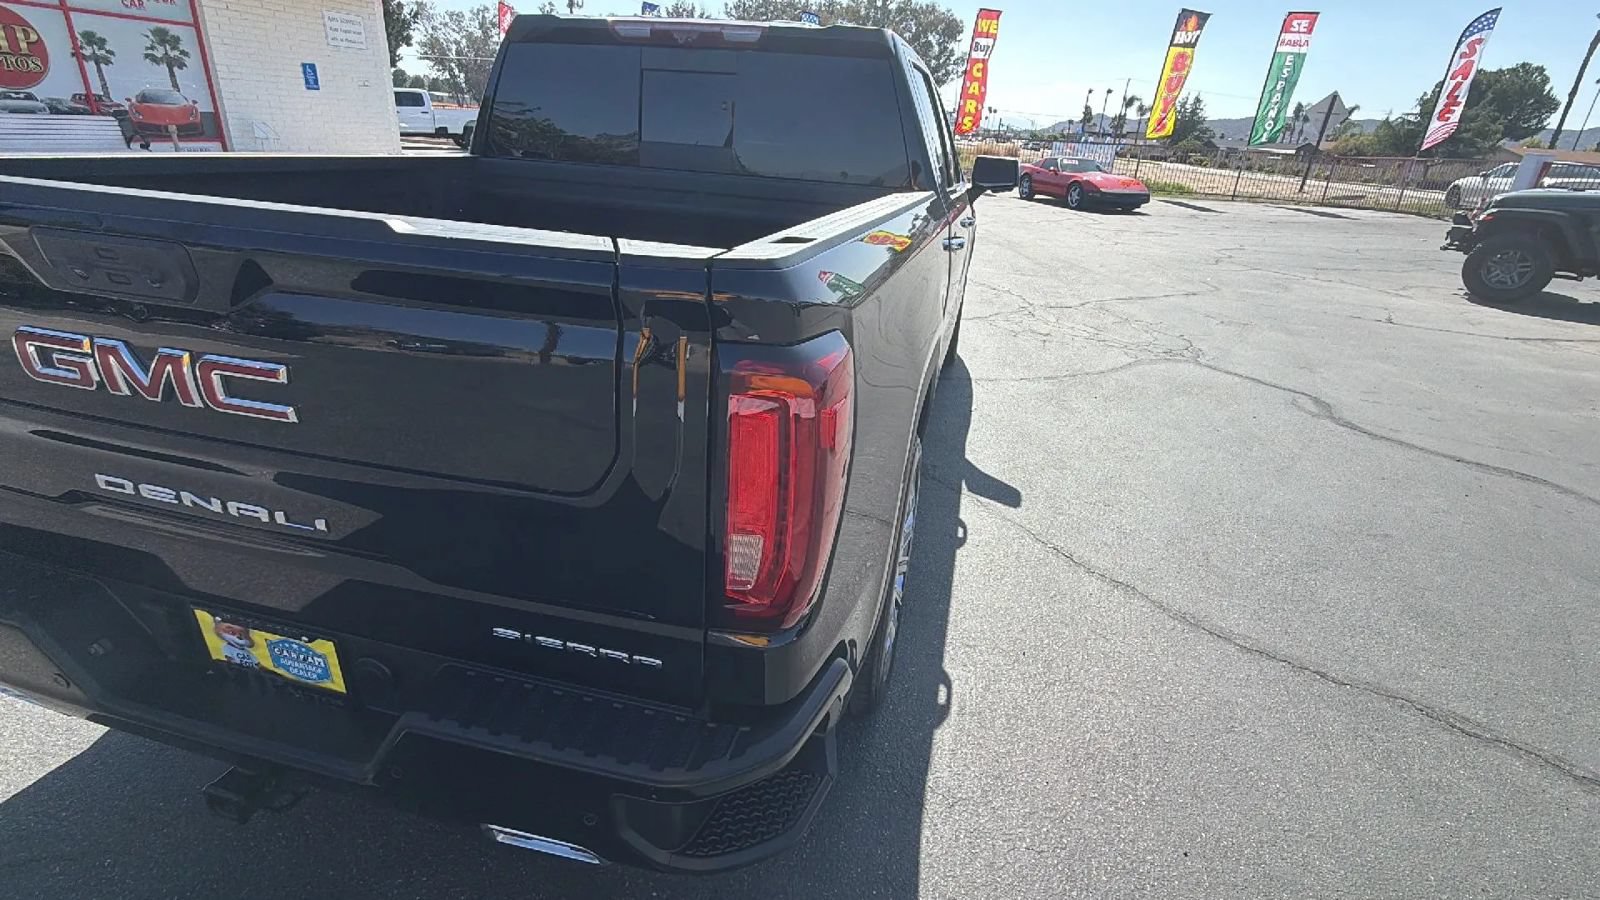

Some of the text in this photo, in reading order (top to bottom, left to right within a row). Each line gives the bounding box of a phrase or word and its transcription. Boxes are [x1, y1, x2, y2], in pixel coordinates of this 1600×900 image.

[977, 18, 998, 33] WE
[1173, 30, 1201, 44] HOT
[1279, 38, 1309, 48] HABLA
[1289, 19, 1311, 33] SE
[962, 62, 984, 130] CARS
[1437, 37, 1485, 122] SALE
[12, 325, 299, 423] GMC
[95, 474, 328, 532] DENALI
[493, 627, 662, 669] SIERRA
